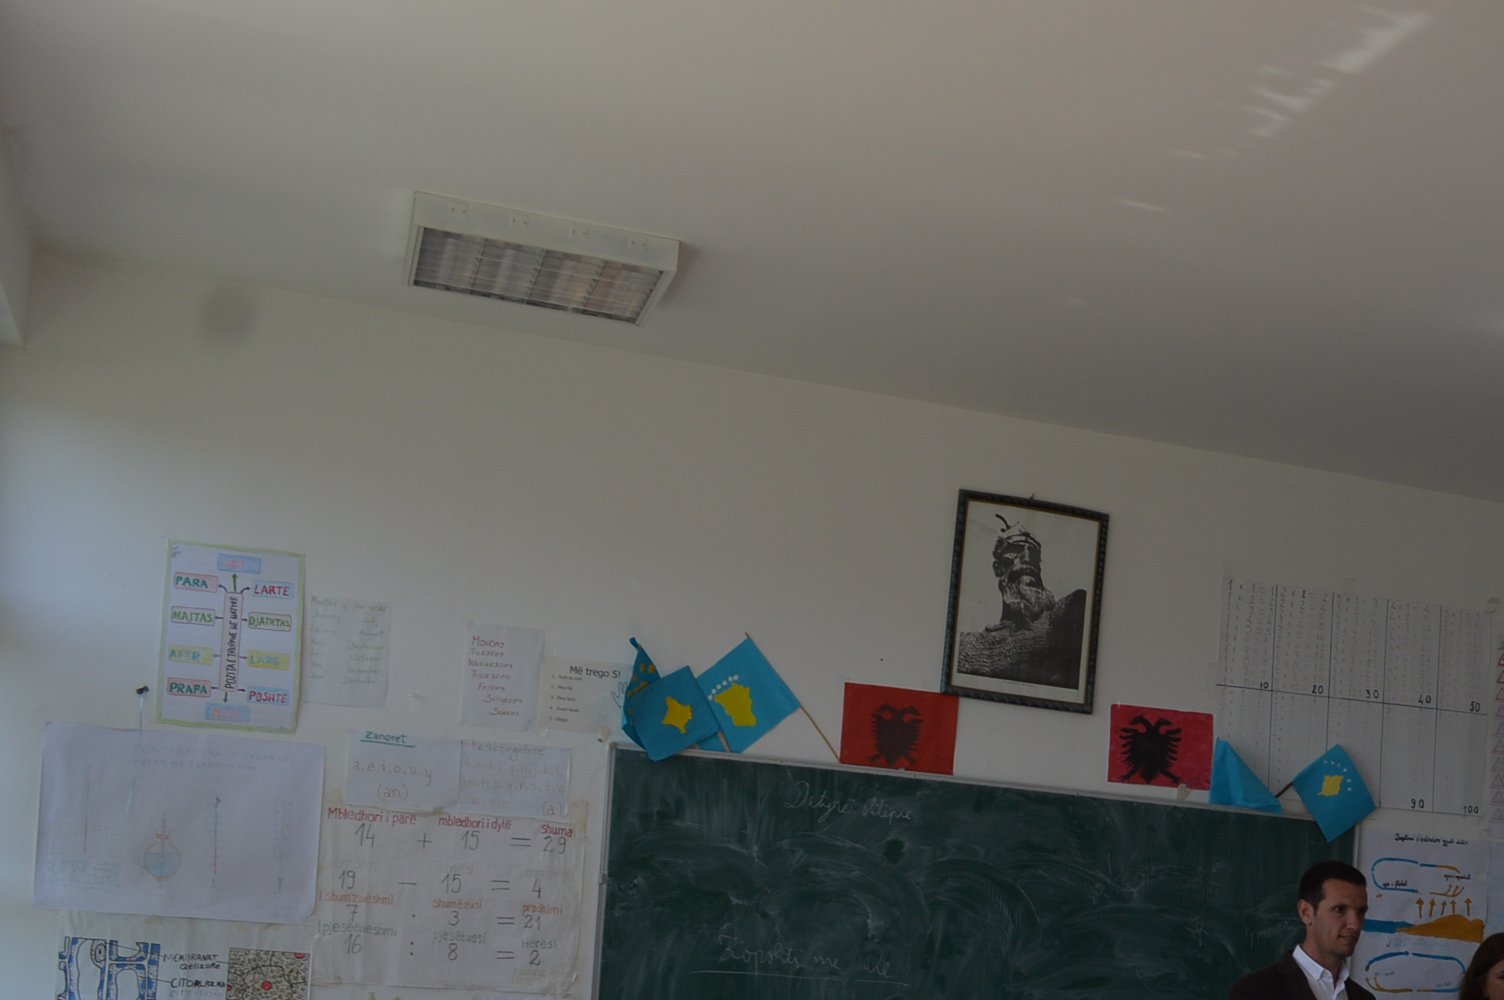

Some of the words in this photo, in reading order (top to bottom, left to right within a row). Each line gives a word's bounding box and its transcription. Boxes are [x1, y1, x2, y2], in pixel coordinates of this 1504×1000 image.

[175, 576, 209, 589] PARA
[172, 611, 213, 623] MAJTAS
[586, 667, 610, 679] trego
[169, 681, 208, 695] PRAPA
[1260, 681, 1270, 690] 10
[1311, 684, 1324, 695] 20
[1365, 688, 1380, 700] 30
[1418, 694, 1432, 705] 40
[1469, 701, 1482, 713] 50
[1410, 798, 1425, 810] 90
[1463, 804, 1480, 815] 100
[355, 822, 375, 848] 14
[461, 829, 480, 851] 15
[543, 835, 567, 855] 29
[338, 869, 357, 890] 19
[440, 873, 462, 895] 15
[531, 877, 542, 901] 4
[346, 904, 358, 922] 7
[448, 911, 460, 927] 3
[523, 914, 541, 931] 21
[344, 933, 361, 955] 16
[448, 942, 458, 961] 8
[529, 949, 541, 967] 2
